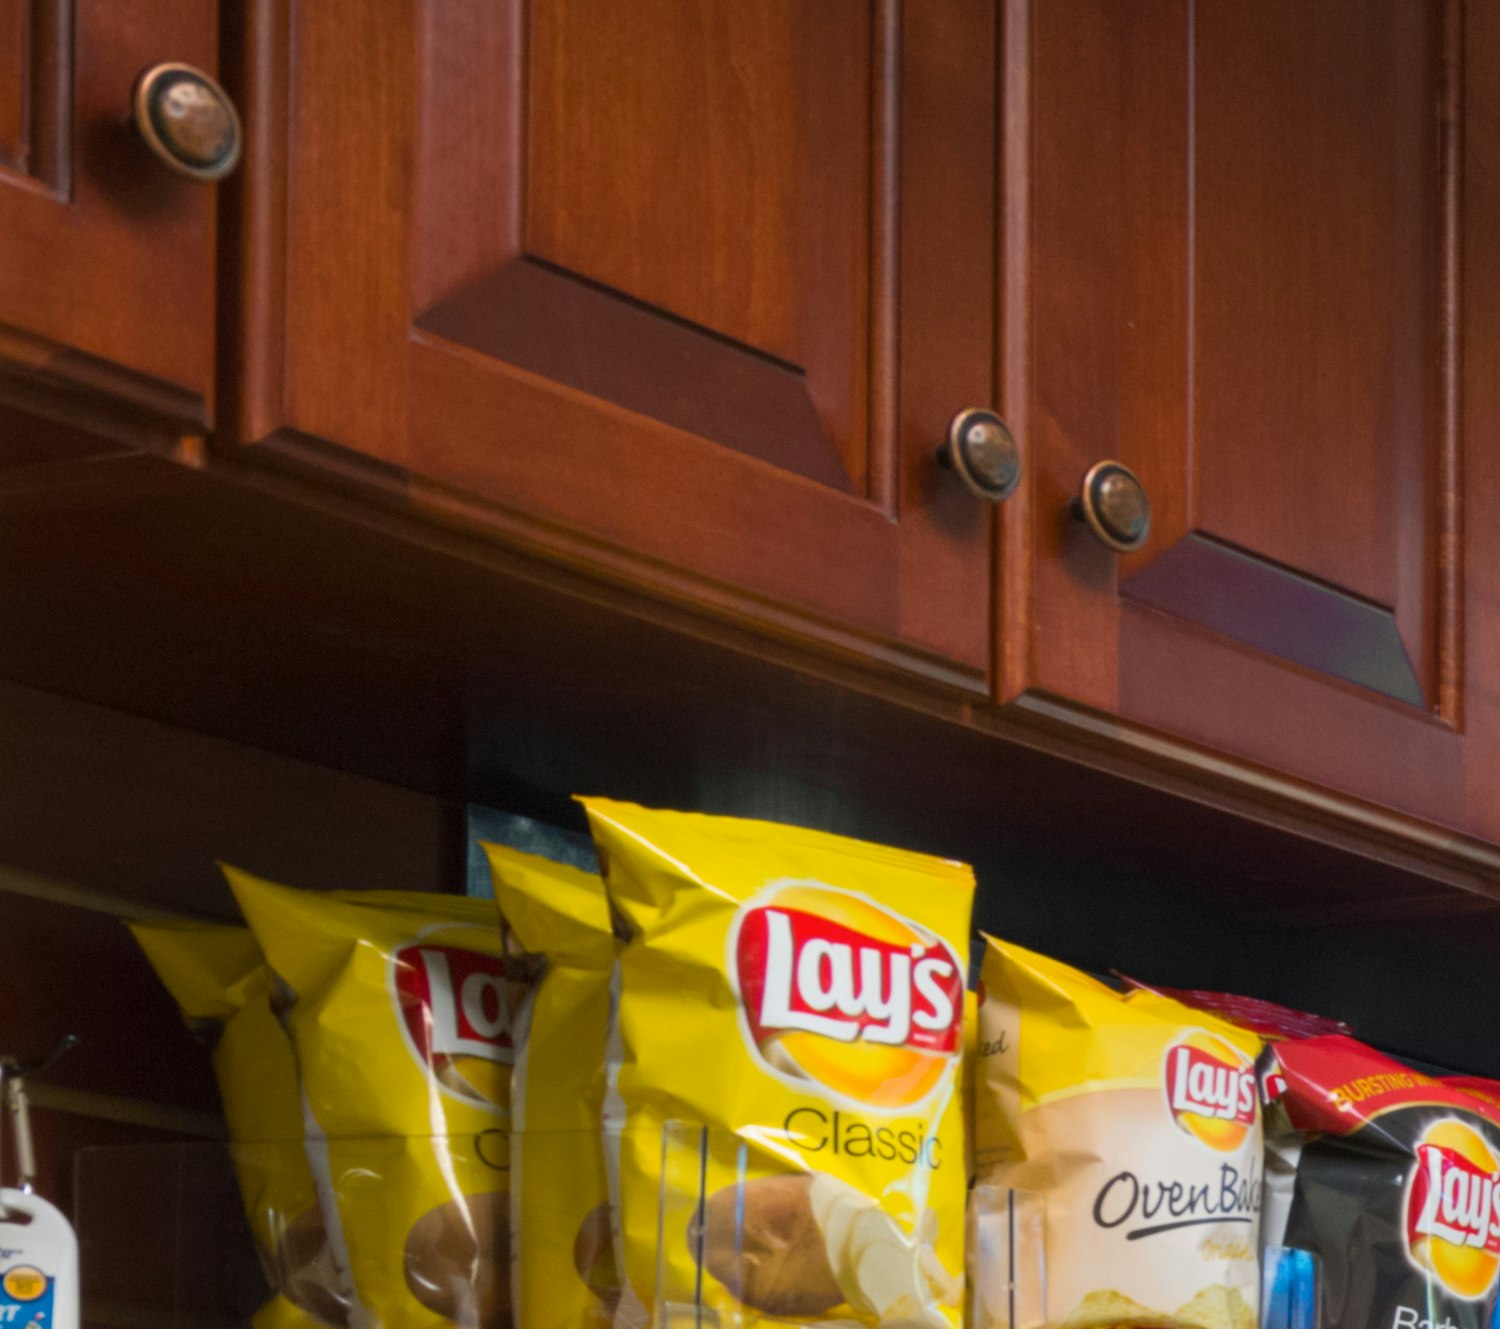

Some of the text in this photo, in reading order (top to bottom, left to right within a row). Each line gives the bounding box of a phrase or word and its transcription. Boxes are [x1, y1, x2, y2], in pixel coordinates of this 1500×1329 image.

[760, 909, 956, 1044] Lay's
[1172, 1047, 1255, 1119] Lay's
[783, 1107, 942, 1173] Classic
